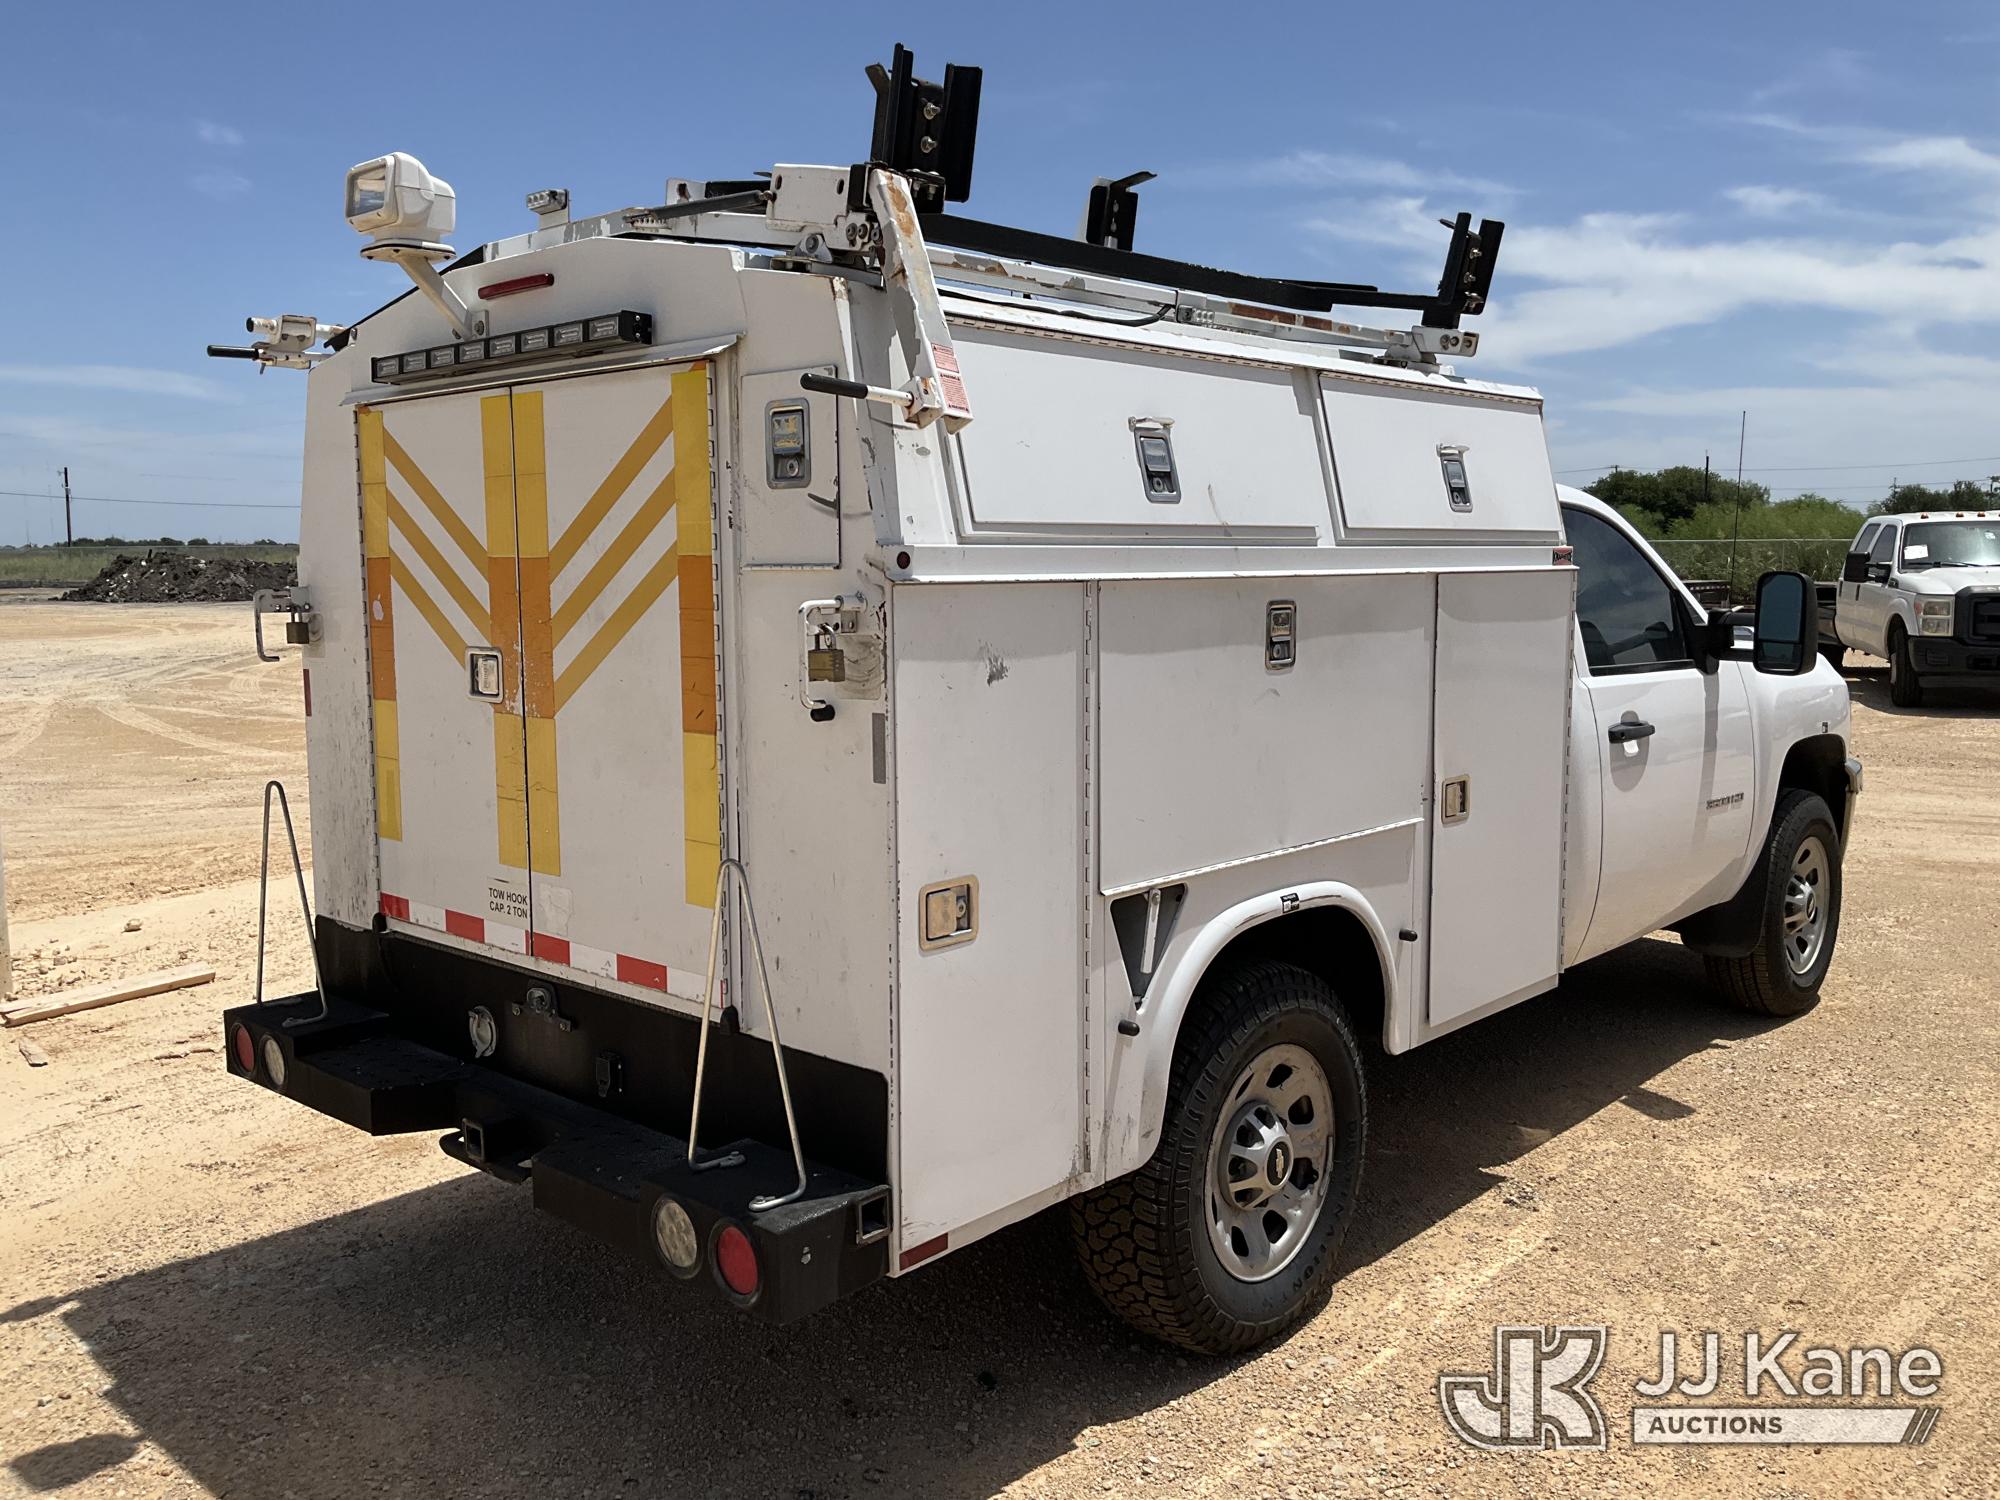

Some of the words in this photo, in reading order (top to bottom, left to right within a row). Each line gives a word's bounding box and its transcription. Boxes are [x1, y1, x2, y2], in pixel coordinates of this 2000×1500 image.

[488, 887, 505, 900] TOW
[506, 891, 528, 906] HOOK
[489, 900, 506, 914] CAP.
[507, 904, 512, 915] 2
[512, 906, 528, 919] TON
